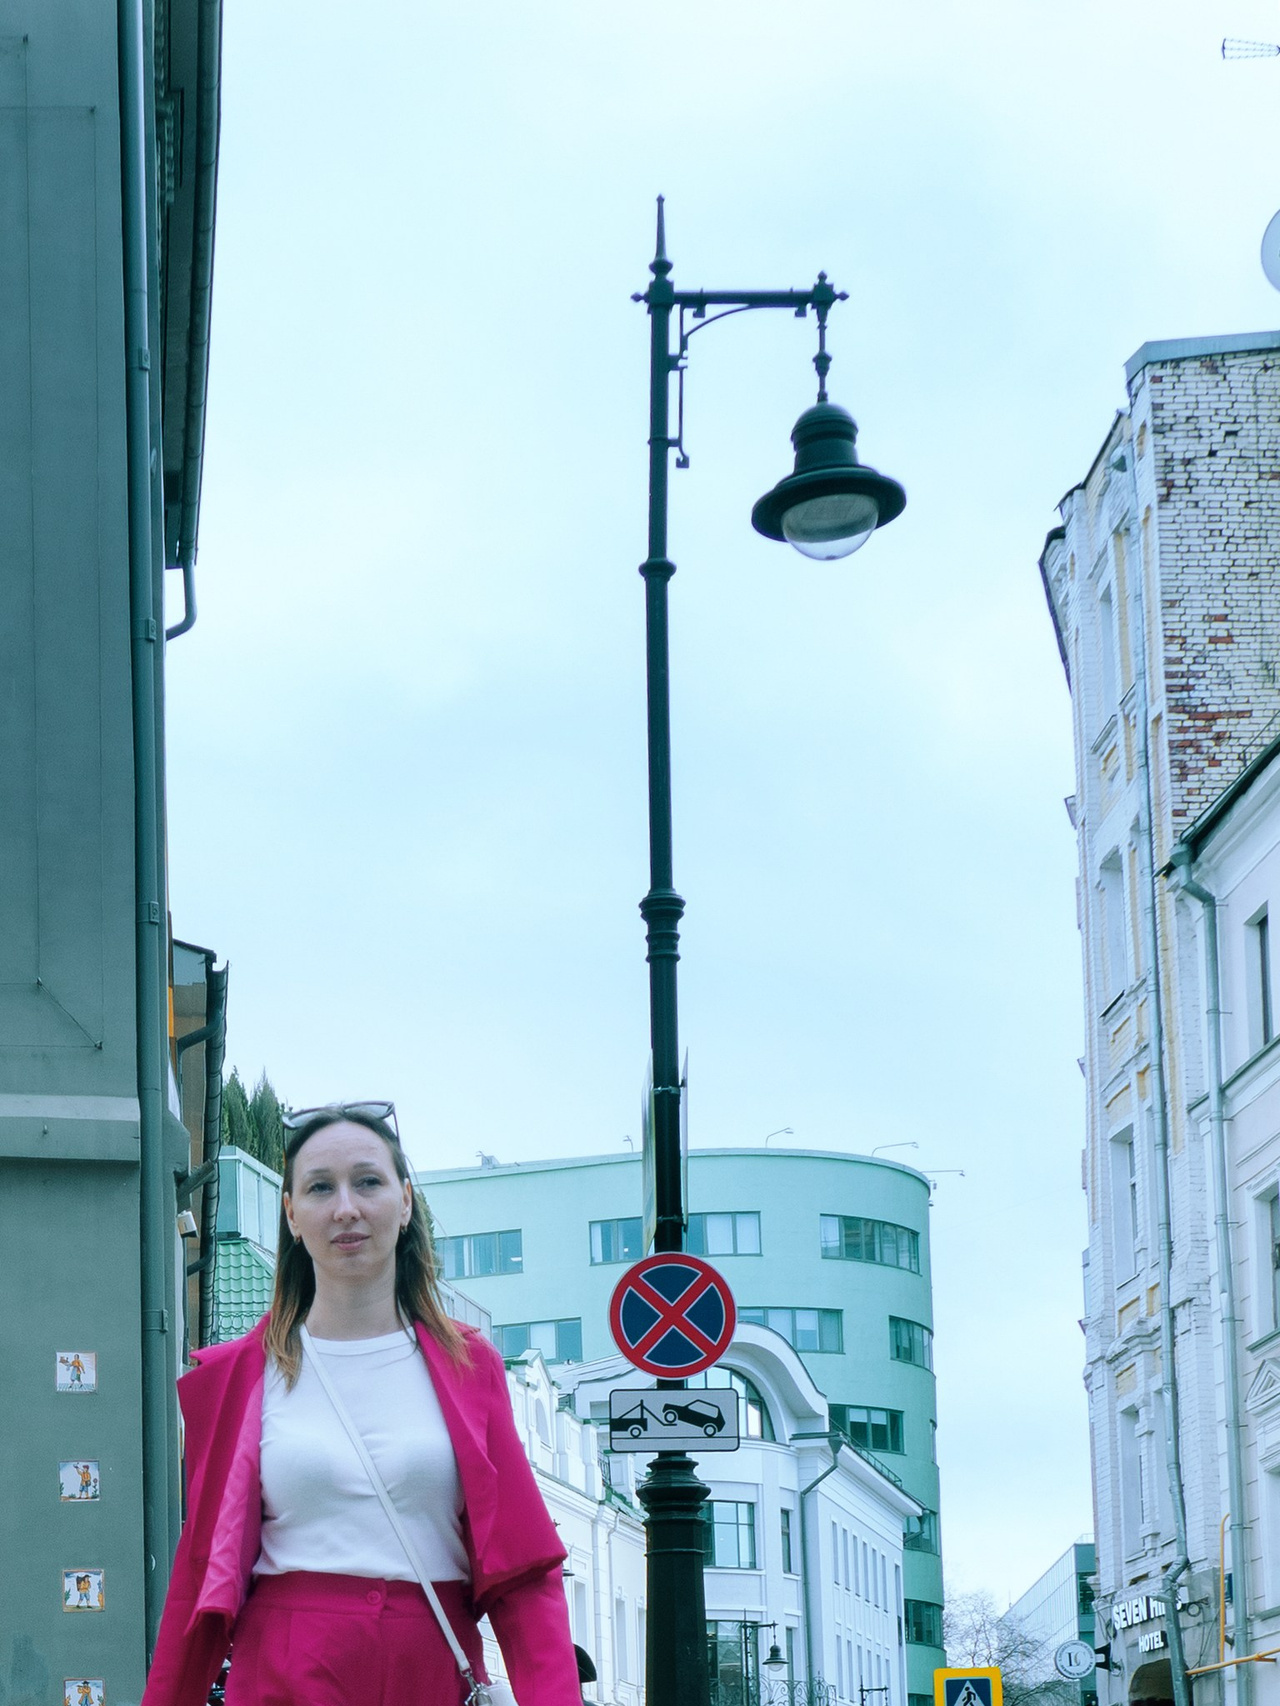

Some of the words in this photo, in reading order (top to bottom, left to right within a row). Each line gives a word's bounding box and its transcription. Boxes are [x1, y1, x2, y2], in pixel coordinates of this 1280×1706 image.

[1112, 1596, 1147, 1630] SEVEN
[1150, 1595, 1182, 1619] HIS
[1139, 1630, 1164, 1653] HOTEL
